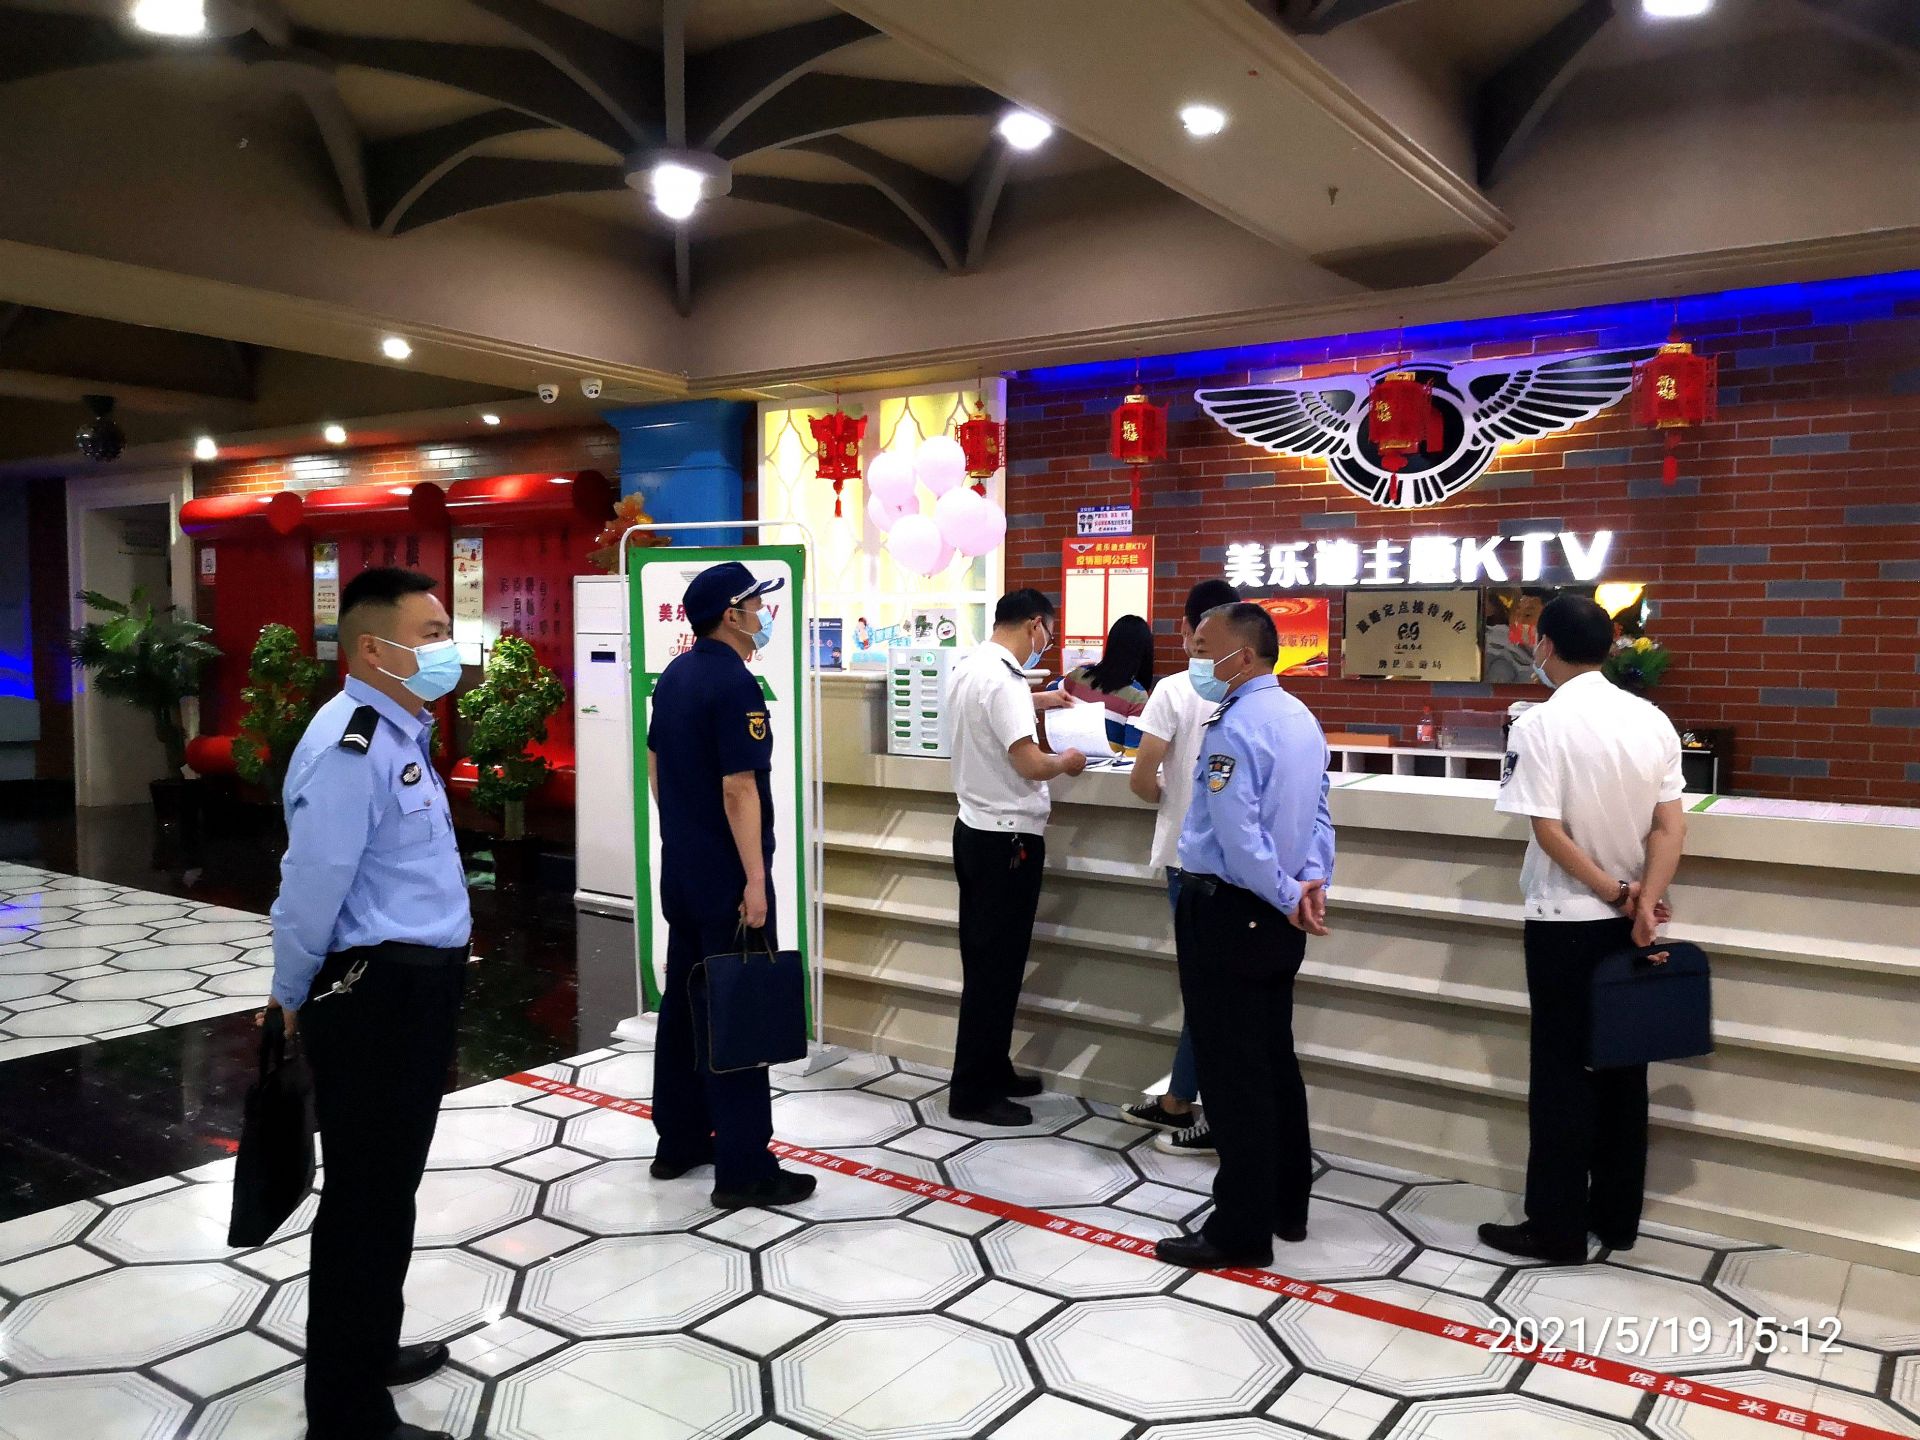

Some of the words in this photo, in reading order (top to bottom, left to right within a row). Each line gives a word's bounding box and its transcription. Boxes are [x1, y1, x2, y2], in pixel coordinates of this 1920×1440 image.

[1628, 1370, 1849, 1438] 保持一米距离
